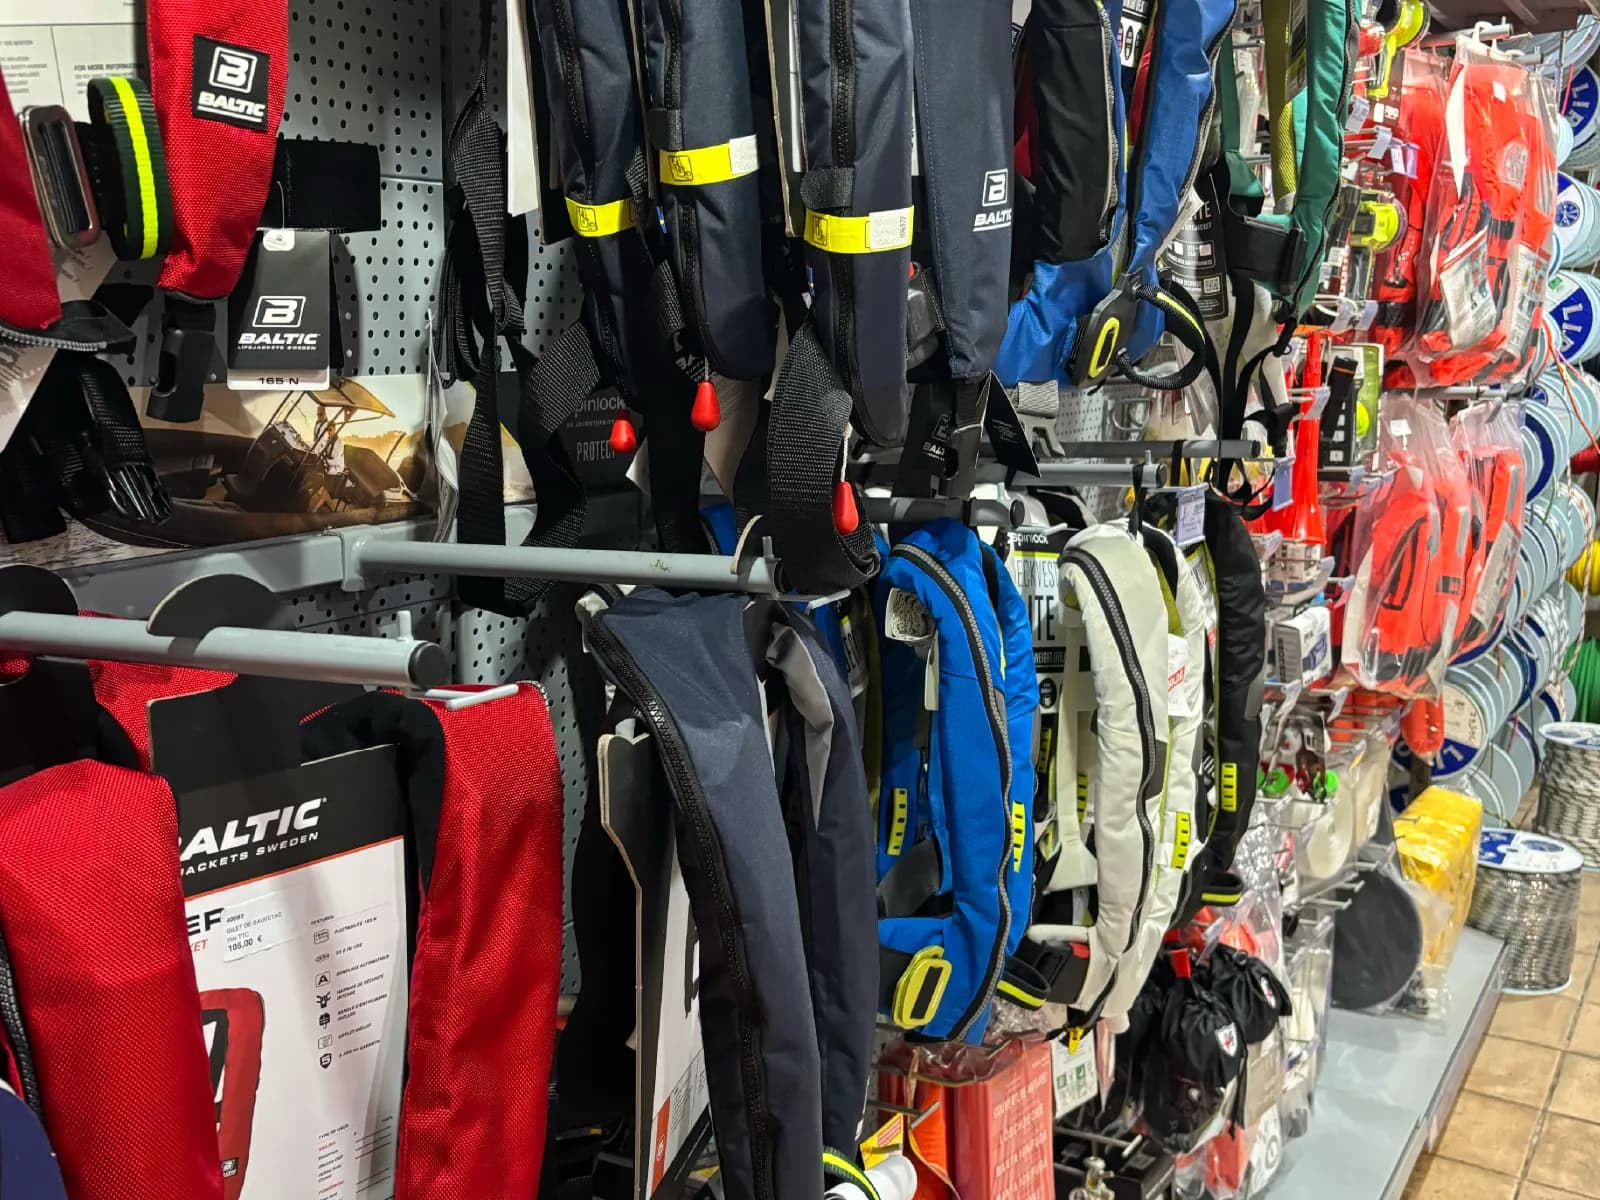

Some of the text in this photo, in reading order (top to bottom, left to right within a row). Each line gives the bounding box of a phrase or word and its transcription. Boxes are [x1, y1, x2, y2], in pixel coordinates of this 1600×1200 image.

[198, 91, 266, 117] BALTIC
[974, 208, 1012, 227] BALTI
[238, 332, 318, 345] BALTIC
[576, 439, 616, 462] PROTEC
[1016, 559, 1060, 588] ECKVEST
[1028, 595, 1056, 641] ITE
[179, 798, 322, 862] ALTIC
[256, 832, 319, 856] SWEDEN
[191, 939, 208, 953] ET
[228, 934, 263, 952] 105,00 €
